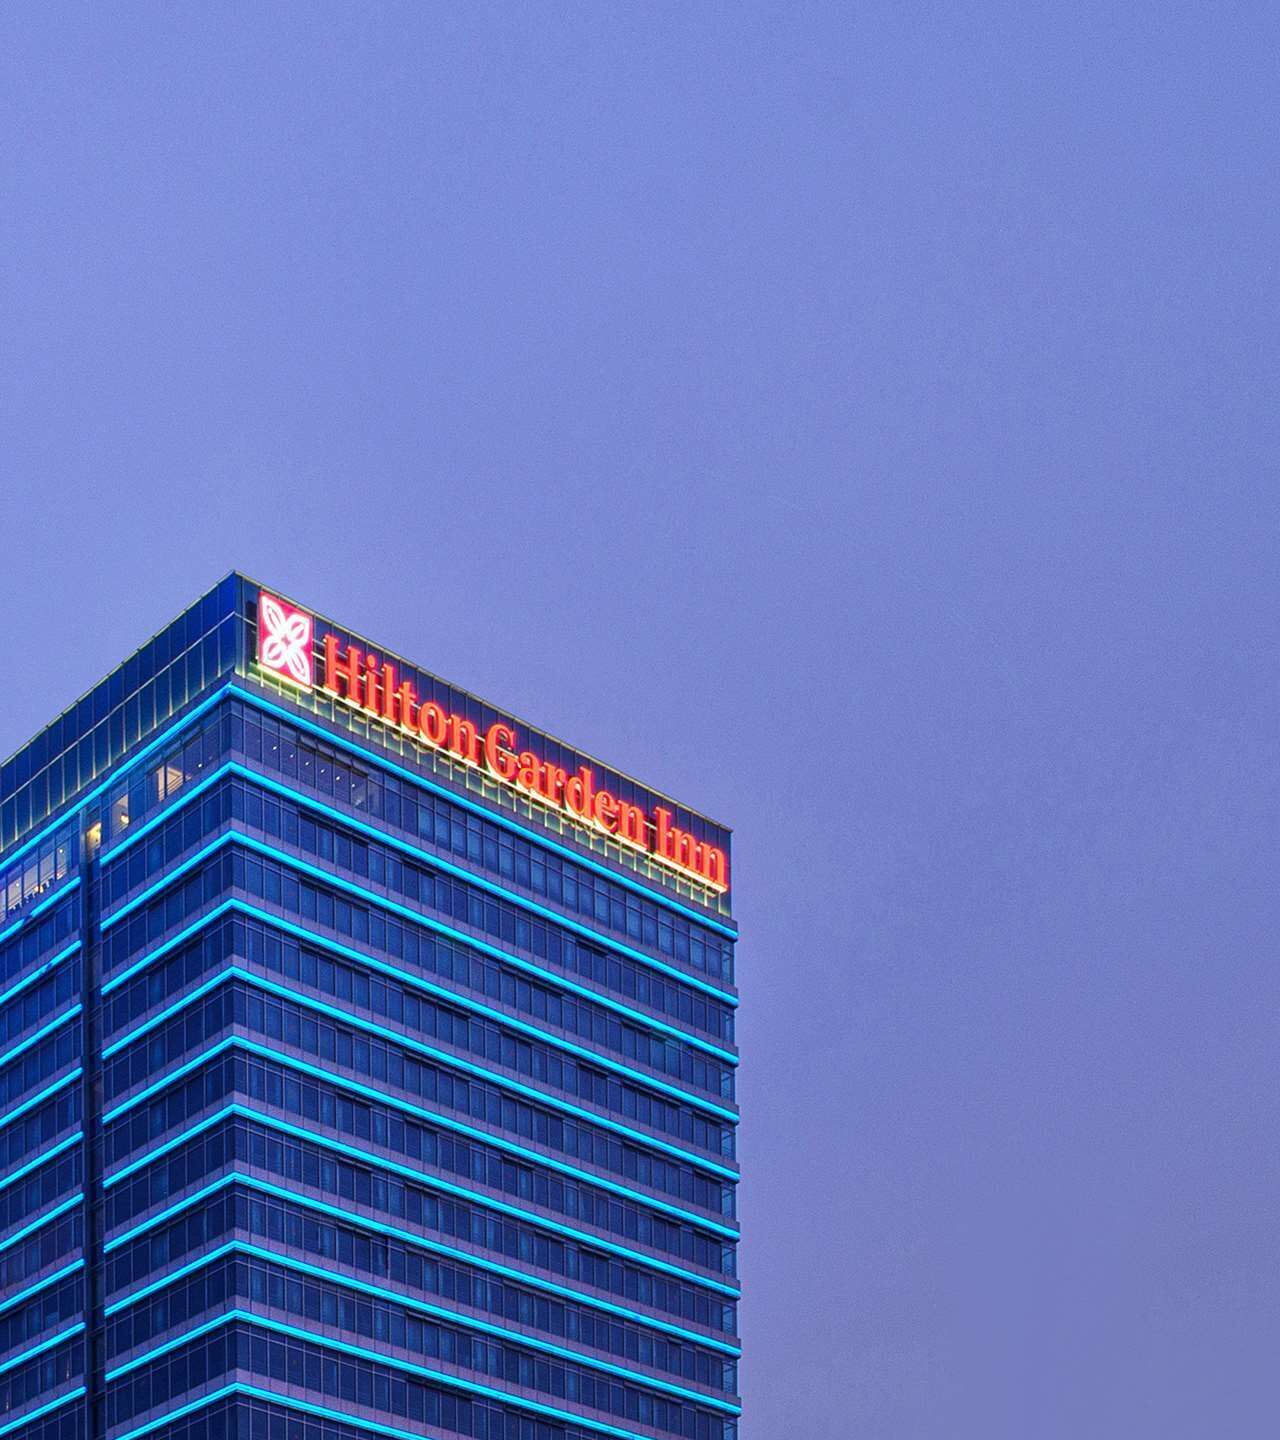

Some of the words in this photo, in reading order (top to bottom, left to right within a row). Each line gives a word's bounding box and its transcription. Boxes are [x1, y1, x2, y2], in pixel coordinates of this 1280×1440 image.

[323, 633, 479, 765] Hilton
[483, 722, 647, 848] Garden
[652, 806, 728, 889] Inn
